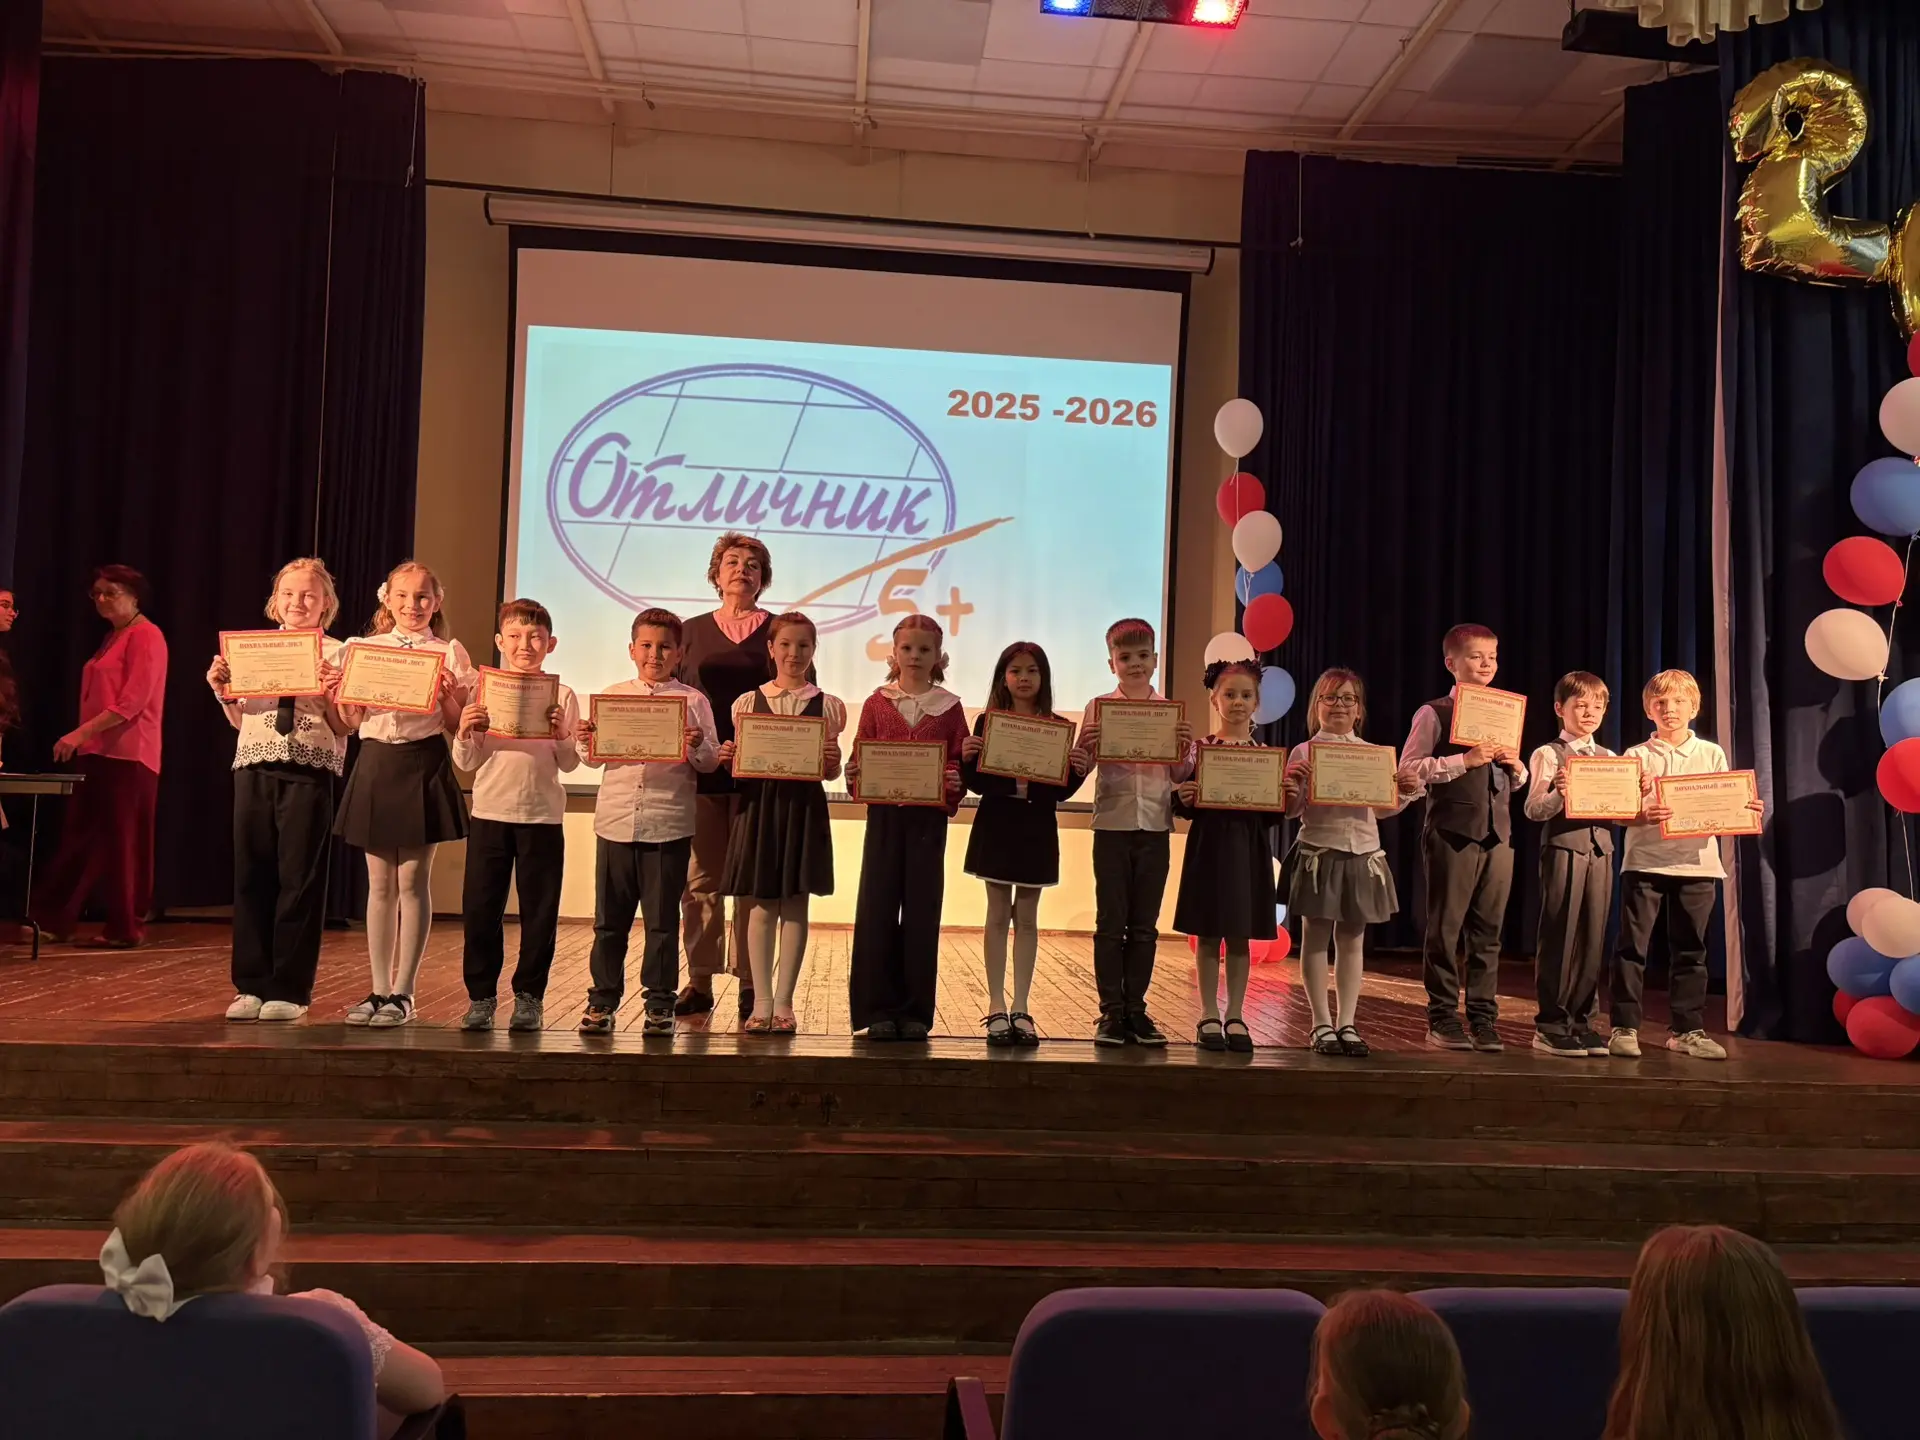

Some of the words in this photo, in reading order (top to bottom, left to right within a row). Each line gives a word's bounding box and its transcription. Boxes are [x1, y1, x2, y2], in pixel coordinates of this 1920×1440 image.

[946, 389, 1041, 421] 2025
[1052, 396, 1158, 428] -2026
[568, 431, 932, 536] Отличник
